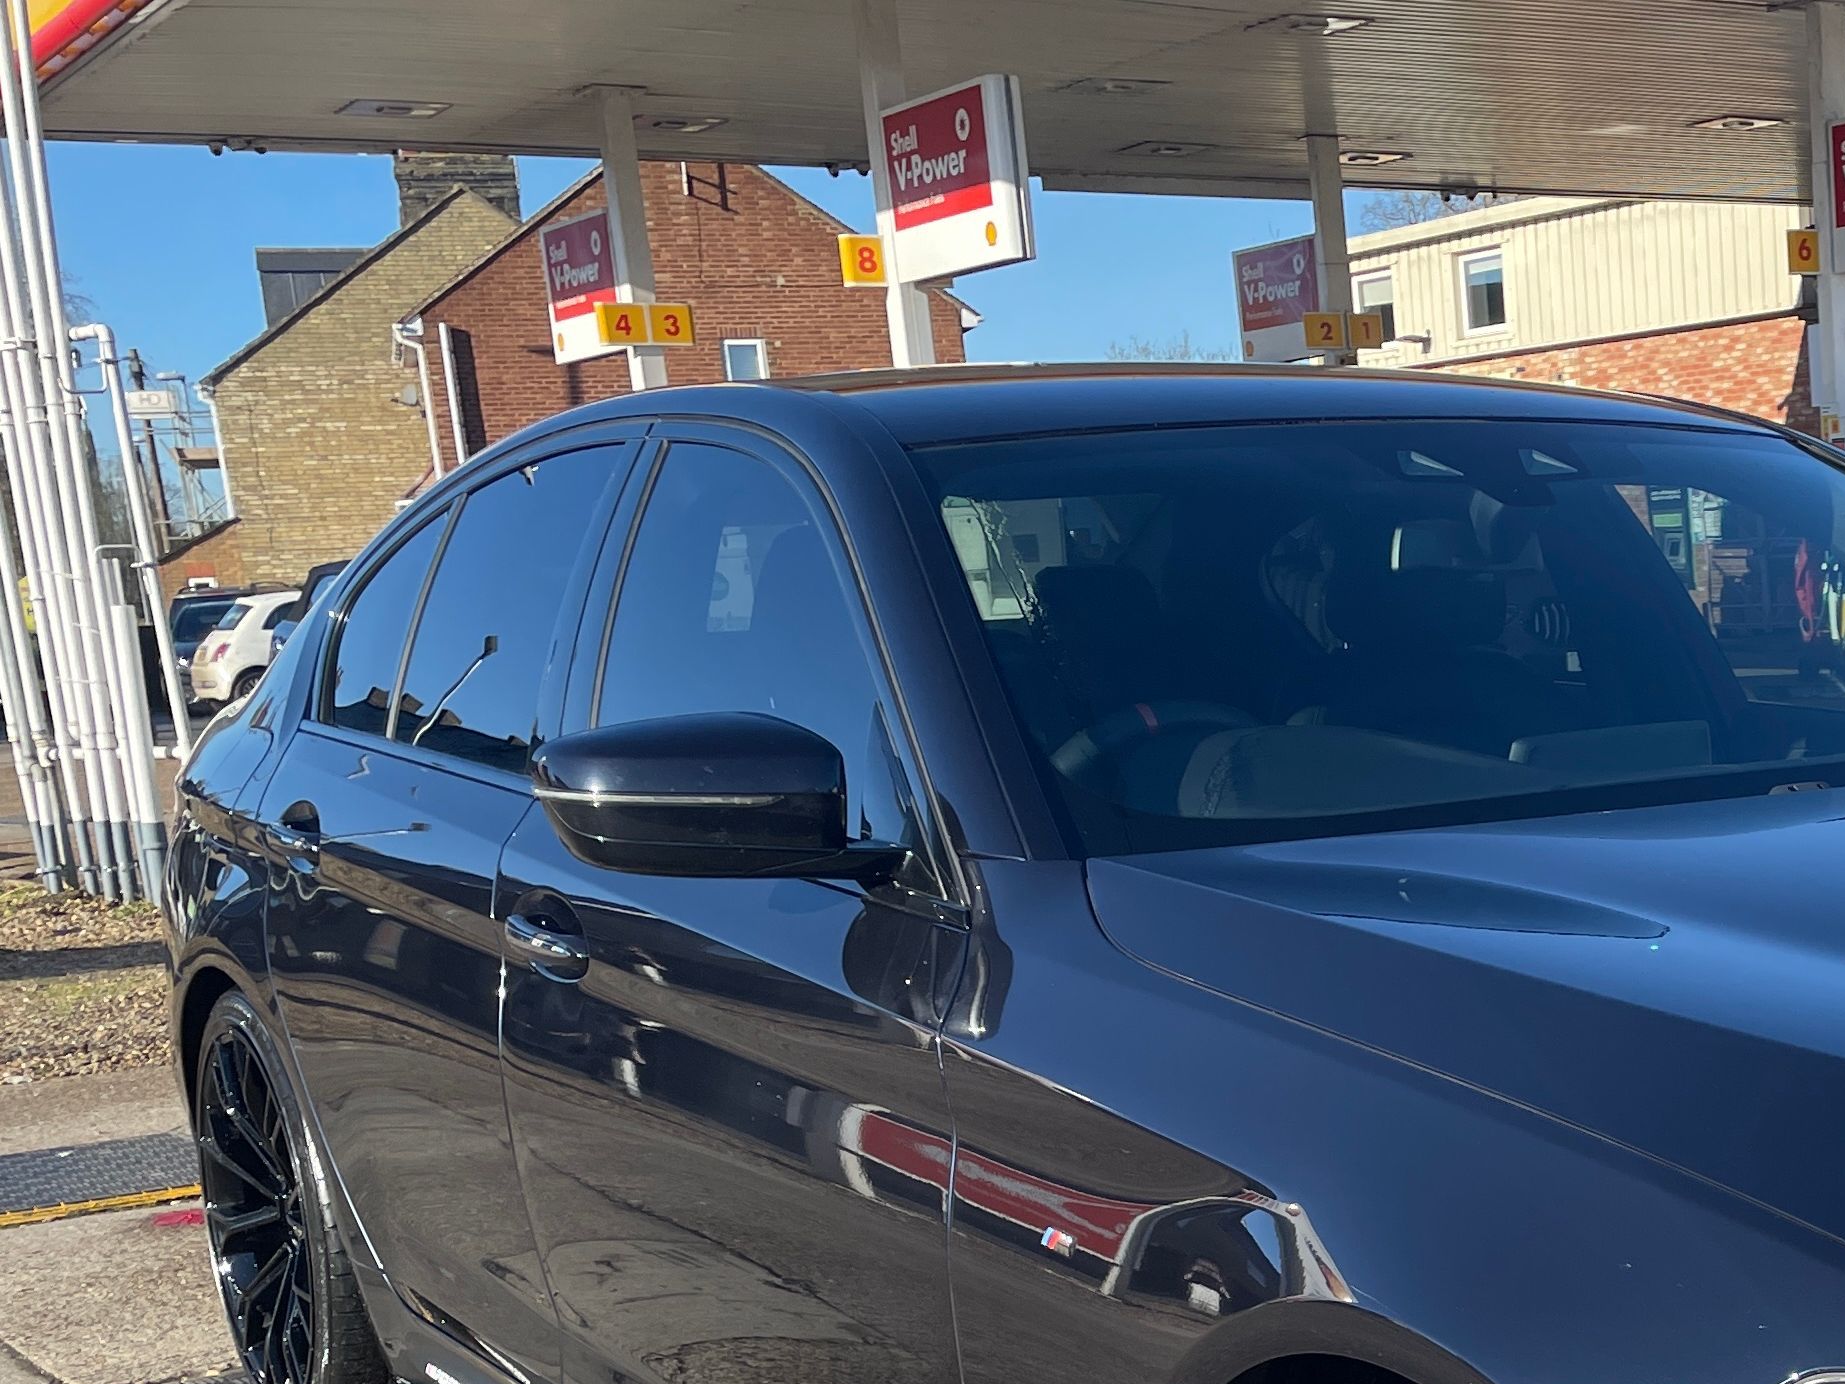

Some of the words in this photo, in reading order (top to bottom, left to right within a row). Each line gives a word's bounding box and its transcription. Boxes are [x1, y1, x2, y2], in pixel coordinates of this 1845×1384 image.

[890, 124, 918, 156] Shell
[893, 148, 967, 192] V-Power
[549, 240, 568, 264] Shell
[857, 246, 877, 273] 8
[1798, 238, 1812, 261] 6
[552, 262, 599, 291] V-Power
[1242, 262, 1264, 282] Shell
[1243, 279, 1301, 305] V-Power
[615, 314, 632, 336] 4
[663, 314, 680, 337] 3
[1320, 322, 1333, 340] 2
[1361, 322, 1370, 340] 1
